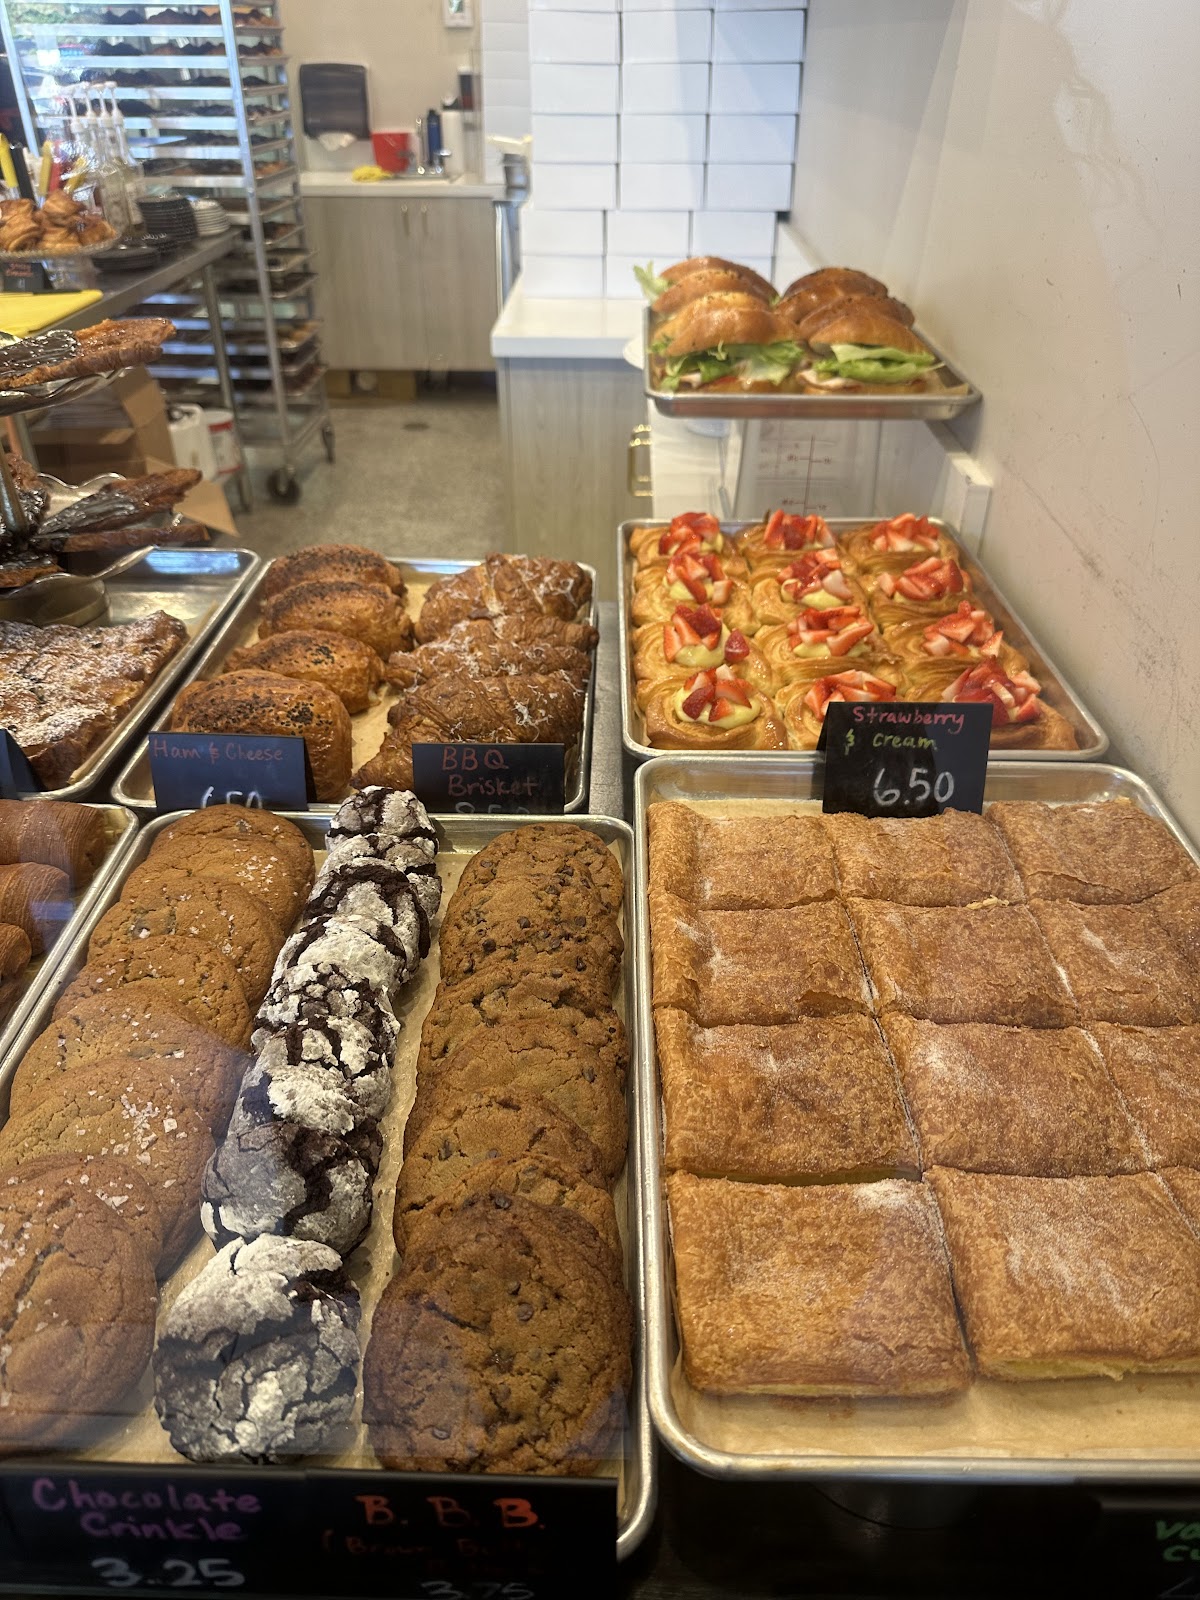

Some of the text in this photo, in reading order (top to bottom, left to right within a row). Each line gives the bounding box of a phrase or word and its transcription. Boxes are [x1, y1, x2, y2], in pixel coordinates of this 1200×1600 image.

[852, 705, 965, 735] Strawberry
[153, 739, 200, 759] Ham
[225, 742, 284, 761] Cheese
[442, 745, 509, 771] BBQ
[448, 774, 538, 797] Brisket
[872, 767, 955, 806] 6.50
[32, 1477, 262, 1513] Chocolate
[80, 1511, 250, 1541] Crinkle
[493, 1497, 546, 1529] B.
[91, 1557, 246, 1587] 3.25
